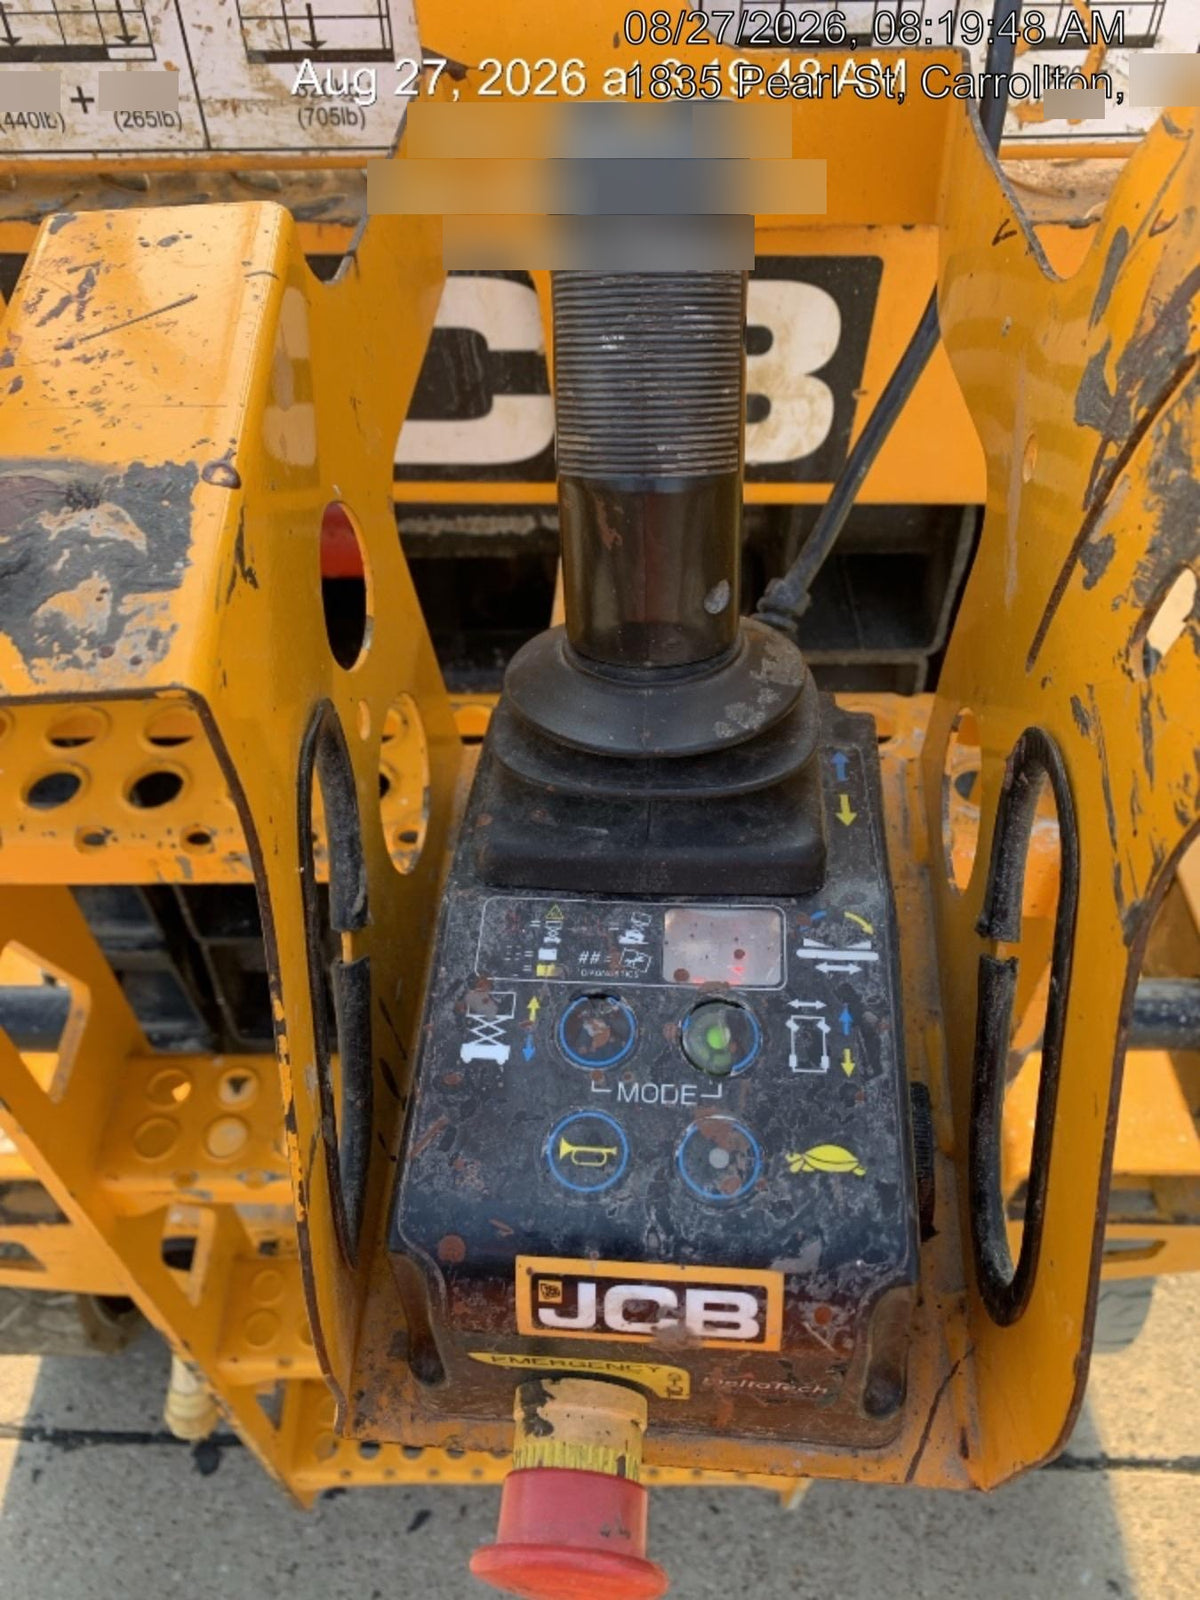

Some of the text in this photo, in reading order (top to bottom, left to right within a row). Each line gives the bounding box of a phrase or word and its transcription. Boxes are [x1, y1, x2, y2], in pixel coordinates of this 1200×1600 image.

[298, 106, 366, 131] (705lb)
[616, 1082, 698, 1105] MODE
[538, 1281, 760, 1339] JCB
[491, 1355, 661, 1374] EMERGENCY
